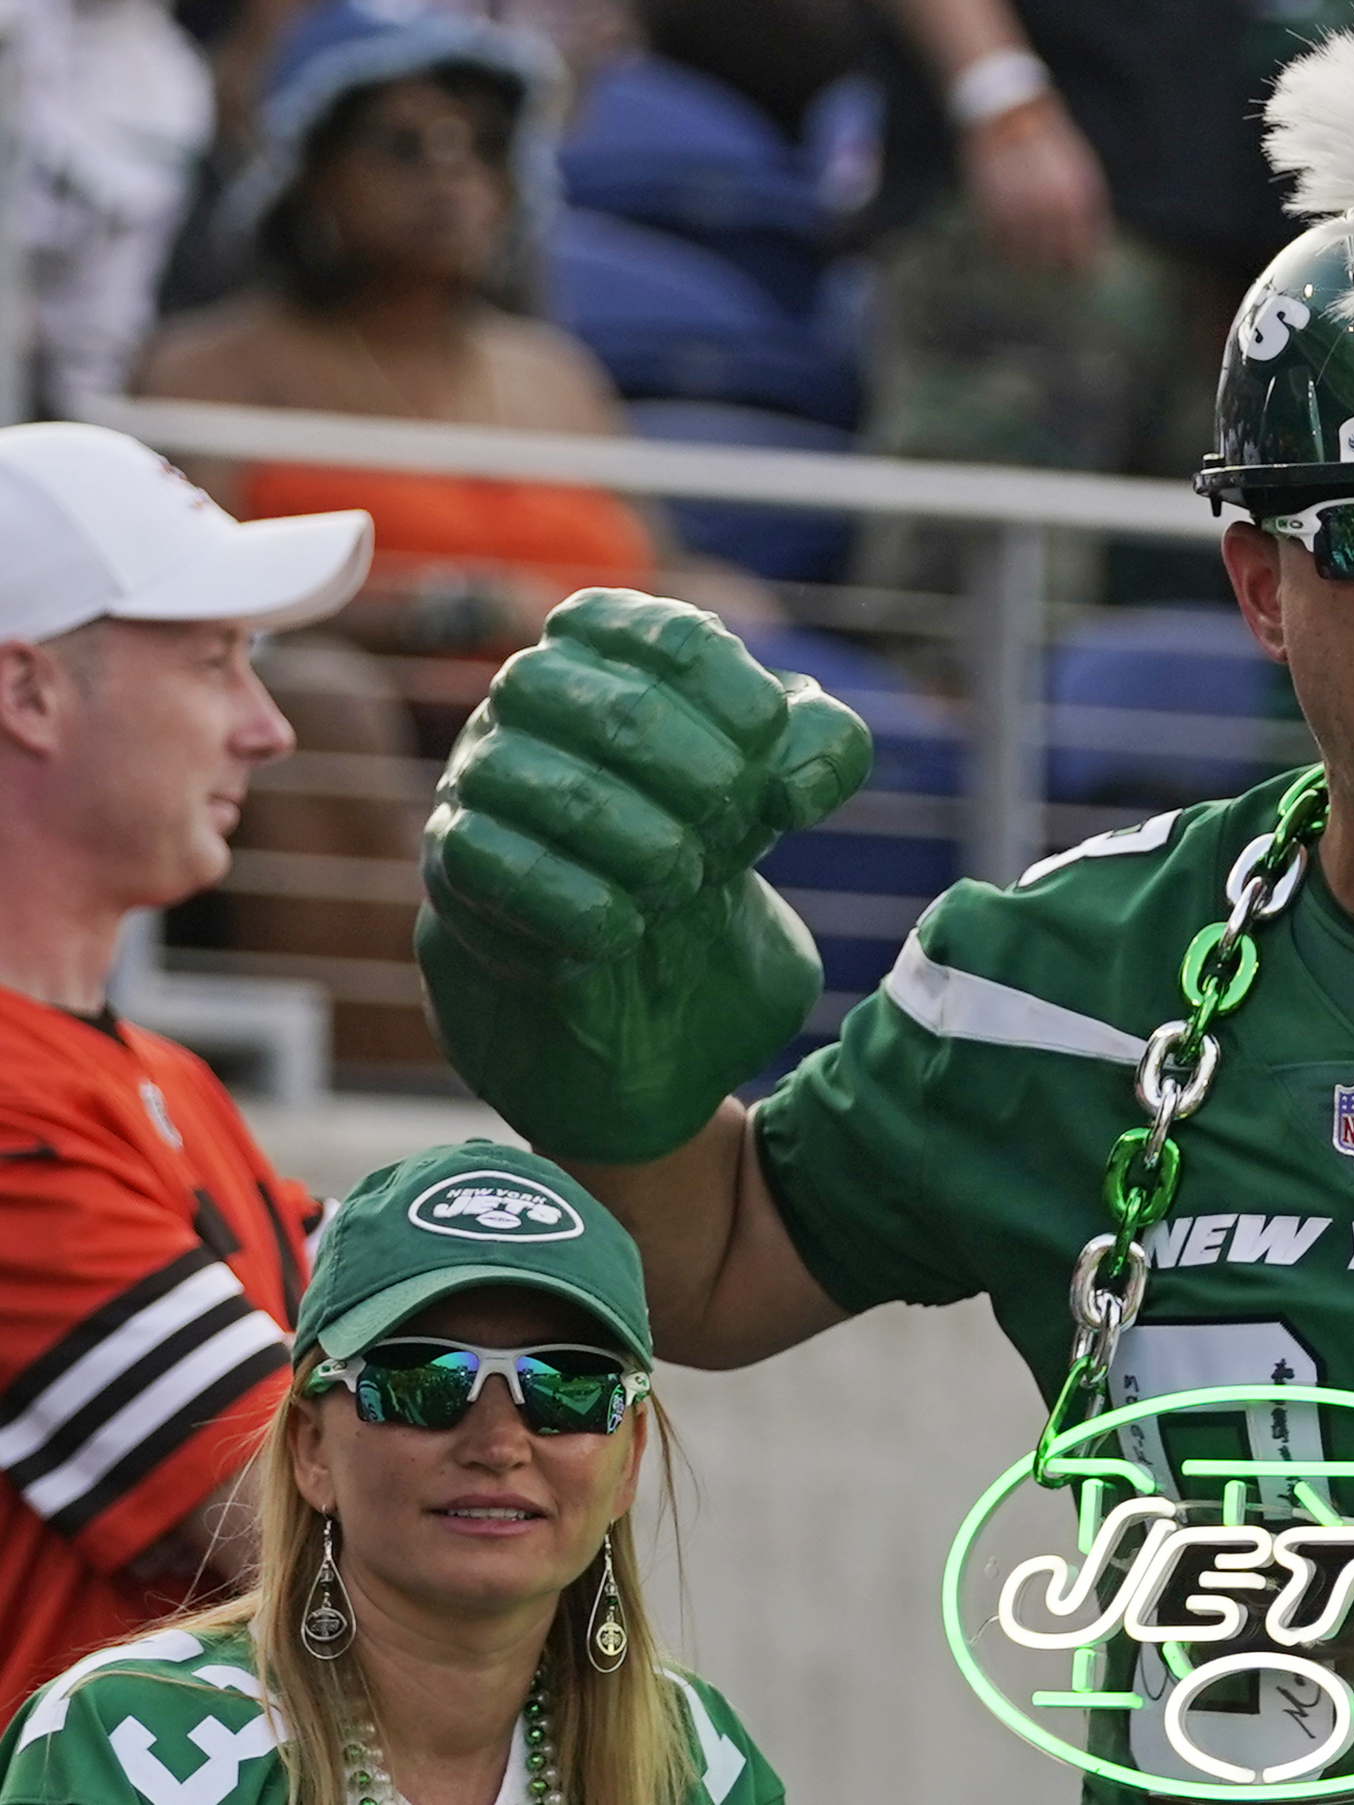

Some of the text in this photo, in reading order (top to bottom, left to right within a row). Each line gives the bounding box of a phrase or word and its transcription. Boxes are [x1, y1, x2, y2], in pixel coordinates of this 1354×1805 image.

[432, 1194, 563, 1225] JETS
[446, 1187, 548, 1204] NEW YORK
[1143, 1212, 1333, 1270] NEW
